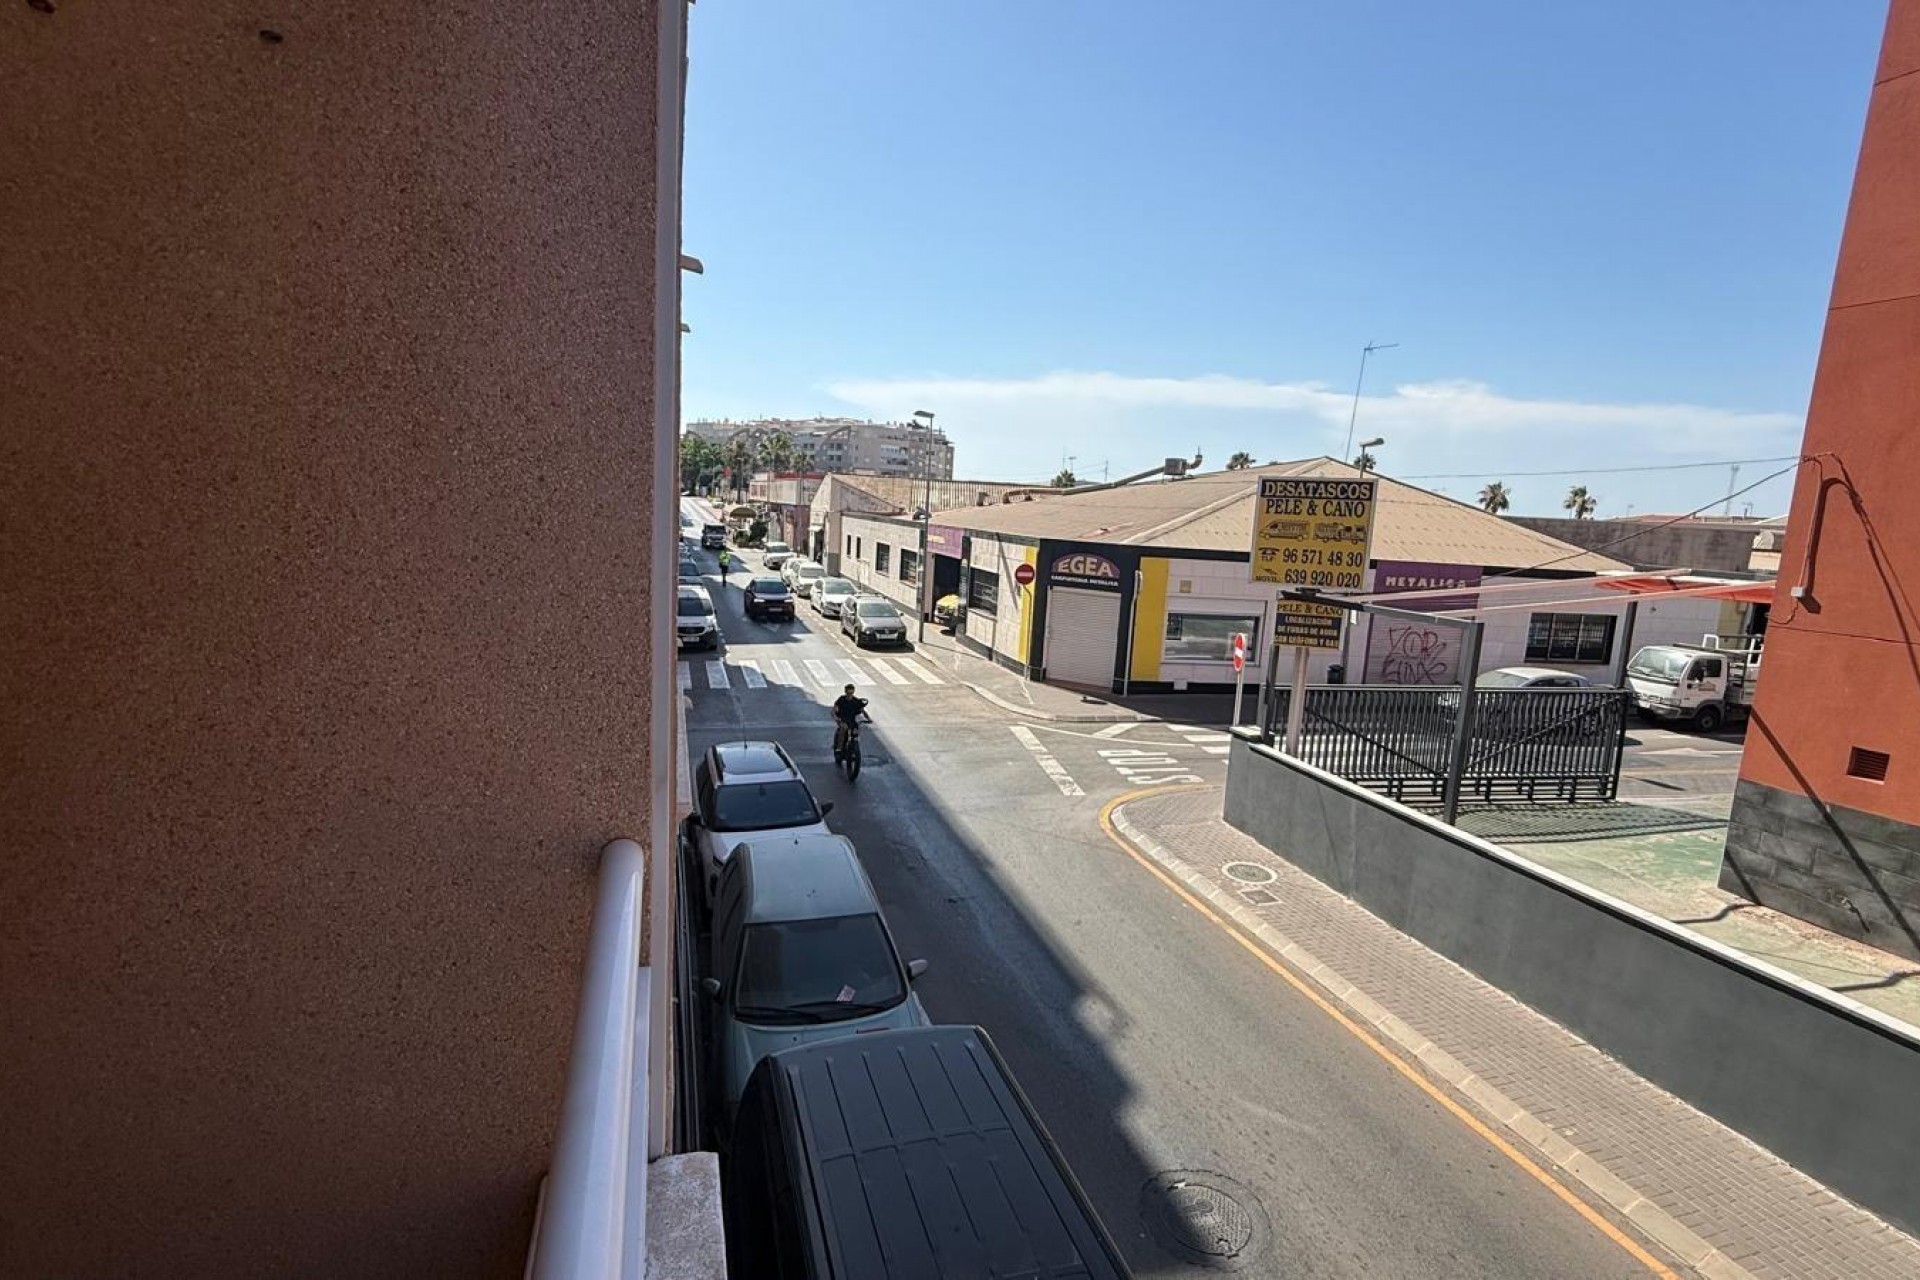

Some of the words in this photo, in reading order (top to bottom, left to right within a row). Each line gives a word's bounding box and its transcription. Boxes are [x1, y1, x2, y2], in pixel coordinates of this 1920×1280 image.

[1264, 481, 1371, 499] DESATASCOS
[1265, 498, 1303, 516] PELE
[1306, 500, 1318, 516] &
[1322, 500, 1365, 518] CANO
[1057, 555, 1114, 577] EGEA
[1282, 548, 1298, 564] 96
[1301, 549, 1323, 565] 571
[1327, 551, 1342, 567] 48
[1346, 552, 1363, 568] 30
[1284, 568, 1307, 584] 639
[1310, 570, 1333, 587] 920
[1336, 572, 1361, 588] 020
[1277, 603, 1303, 613] PELE
[1304, 604, 1313, 613] &
[1315, 605, 1344, 616] CANO
[1097, 749, 1204, 785] STOP
